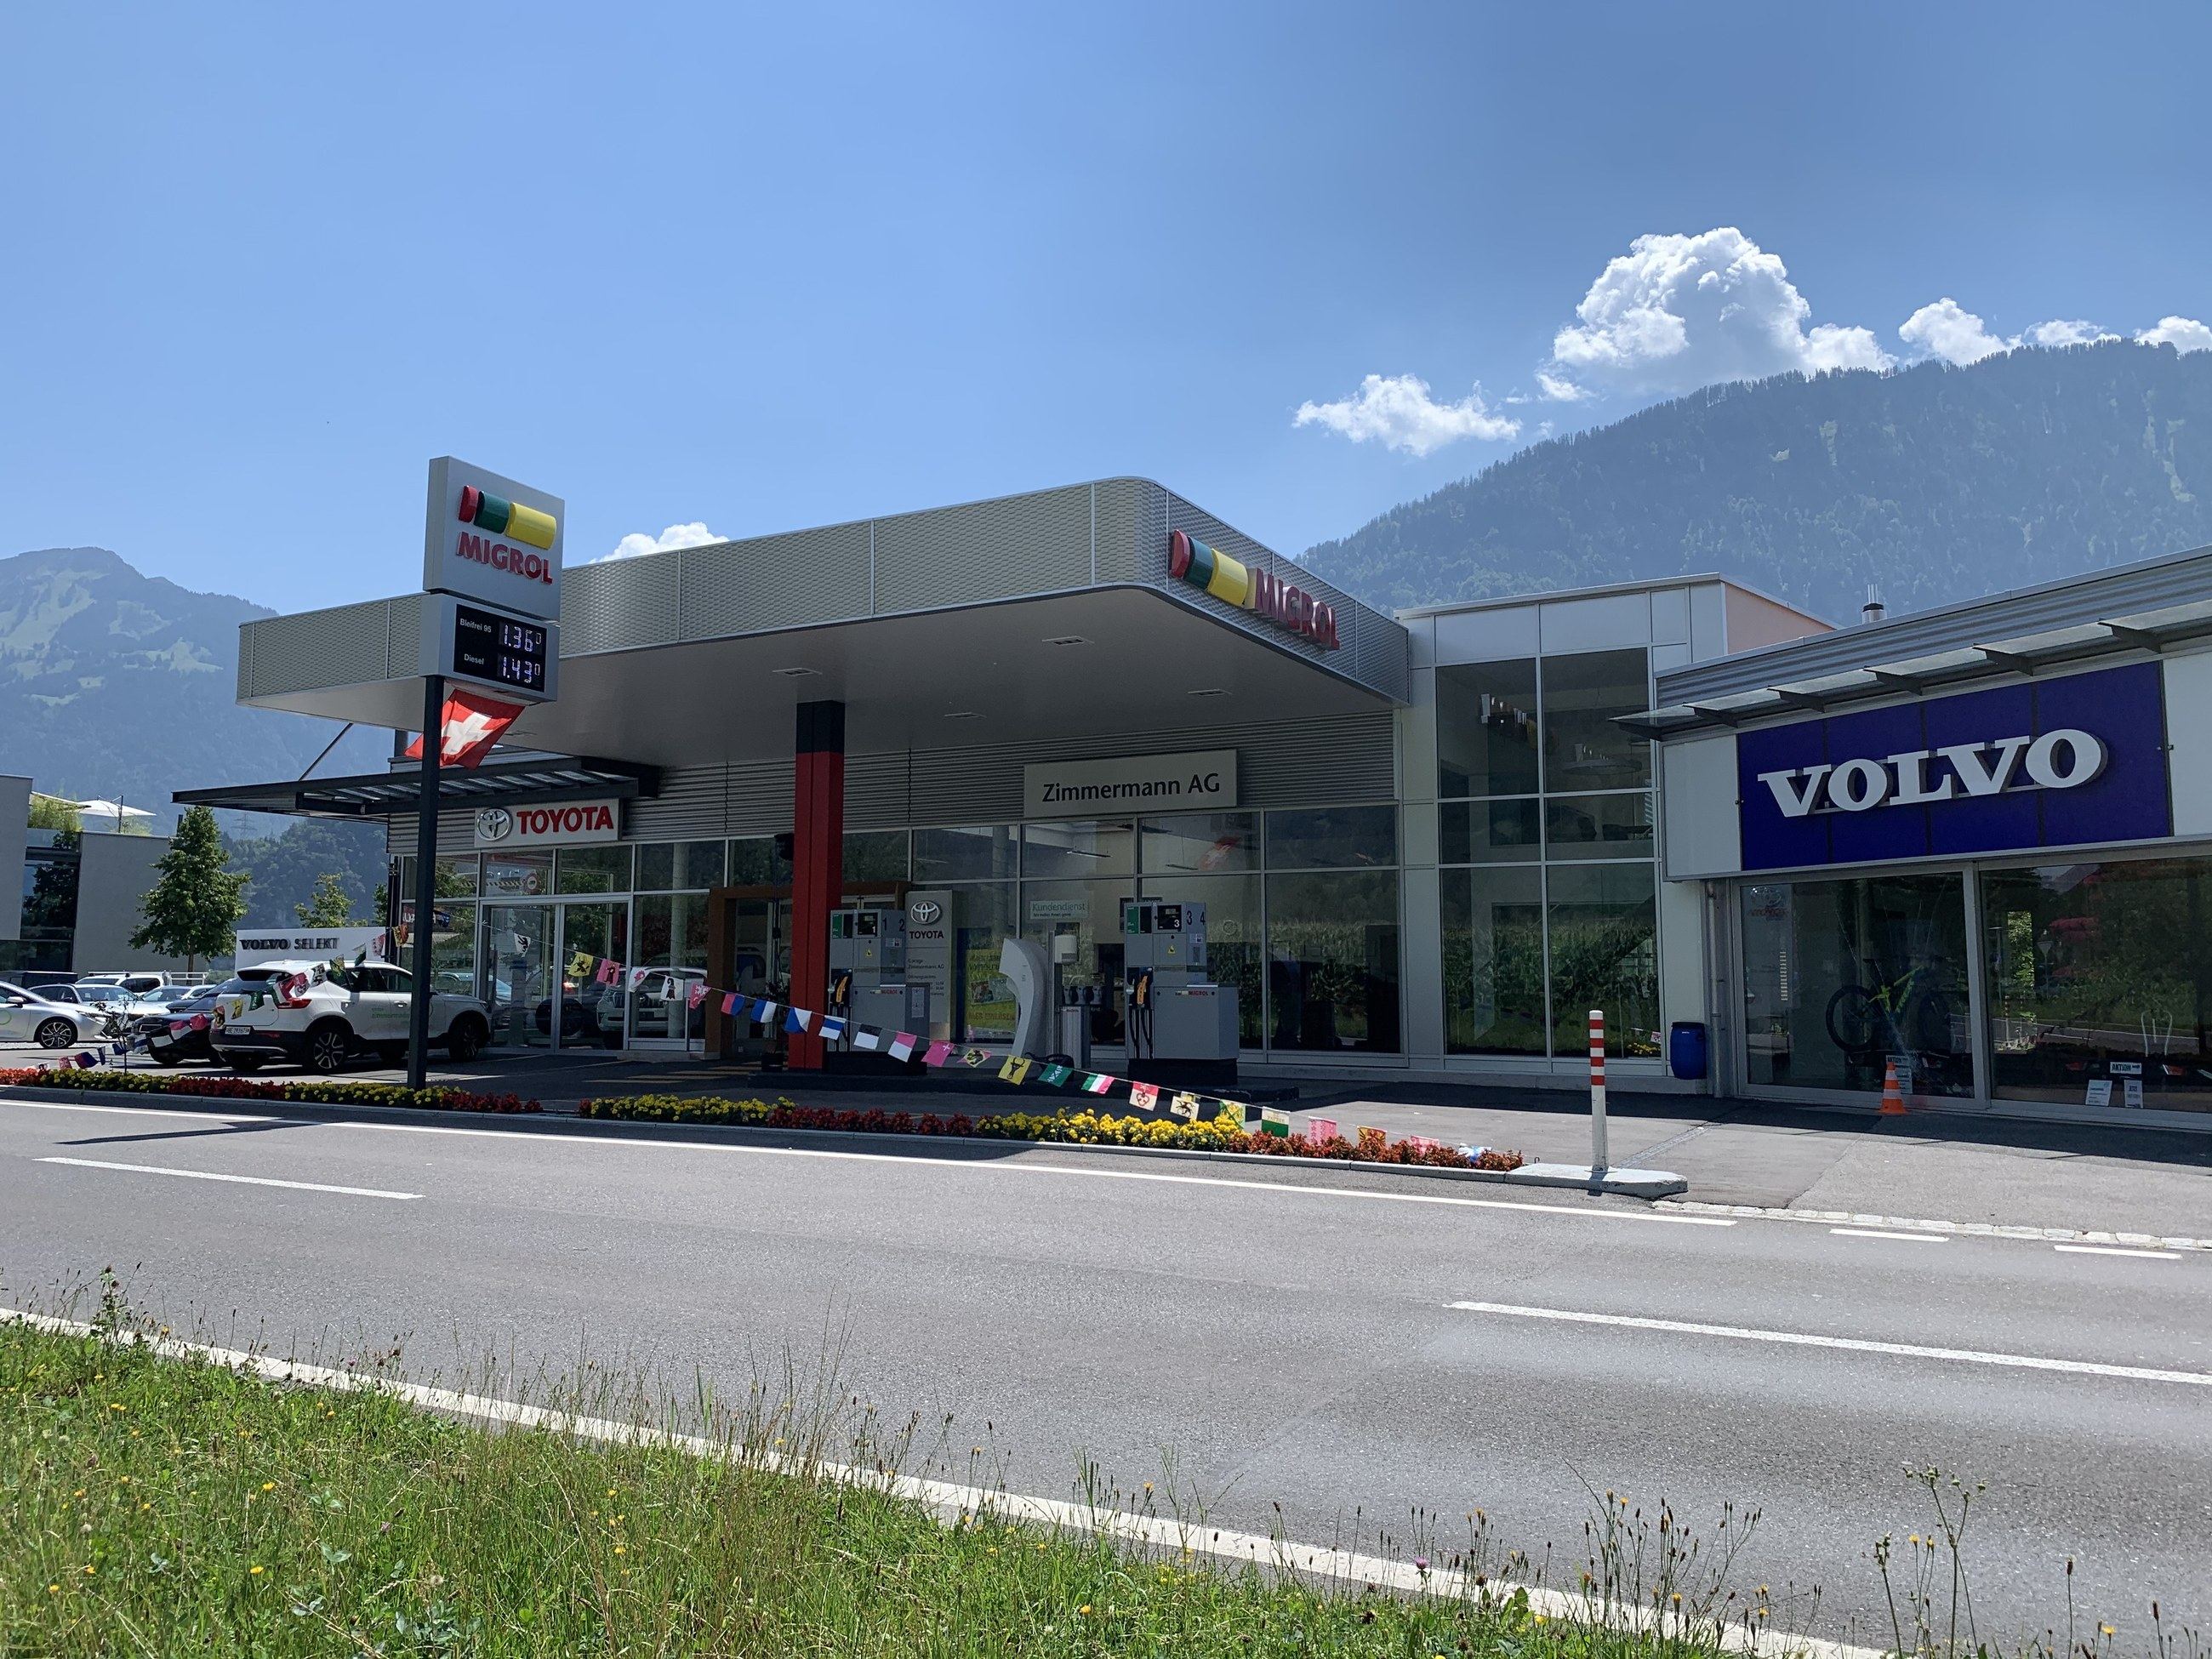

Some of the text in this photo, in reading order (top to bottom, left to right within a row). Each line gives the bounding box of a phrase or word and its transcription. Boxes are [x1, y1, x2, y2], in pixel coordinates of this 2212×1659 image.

[458, 532, 553, 584] MIGROL
[1252, 567, 1340, 650] MIGROL
[459, 618, 482, 630] Bleifrei
[483, 624, 492, 633] 95
[464, 653, 484, 665] Diesel
[1757, 728, 2105, 818] VOLVO
[1042, 772, 1220, 802] Zimmermann AG
[516, 806, 613, 834] TOYOTA
[1032, 902, 1086, 911] Kundendienst
[882, 916, 887, 931] 1
[898, 918, 905, 932] 2
[1173, 919, 1180, 927] 3
[1186, 910, 1193, 925] 3
[1200, 911, 1206, 926] 4
[909, 930, 944, 939] TOYOTA
[239, 938, 290, 950] VOLVO
